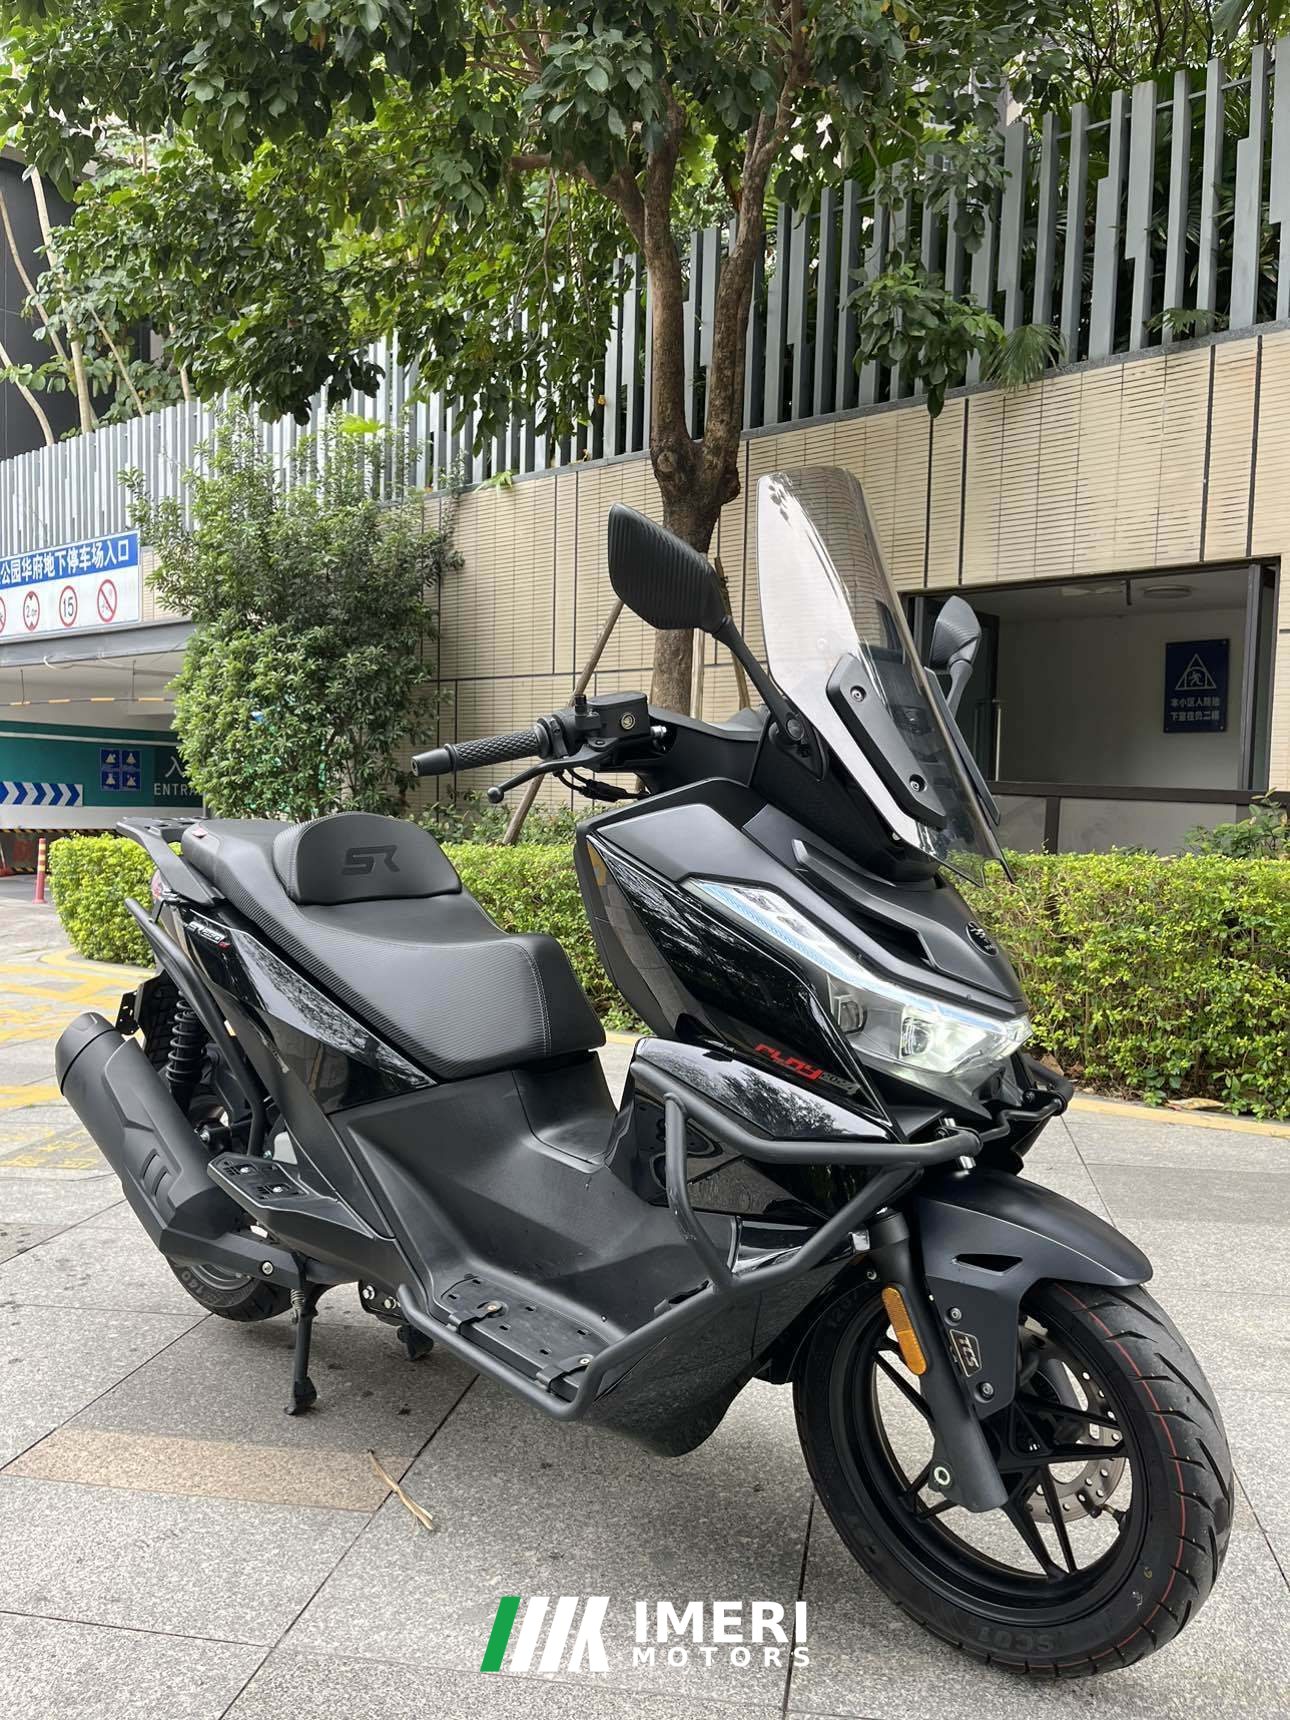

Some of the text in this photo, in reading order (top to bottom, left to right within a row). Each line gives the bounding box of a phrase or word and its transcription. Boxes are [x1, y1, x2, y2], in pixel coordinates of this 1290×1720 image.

[1, 538, 129, 584] 公园华府地下停车场入口
[63, 596, 75, 617] 15
[341, 845, 401, 875] SR
